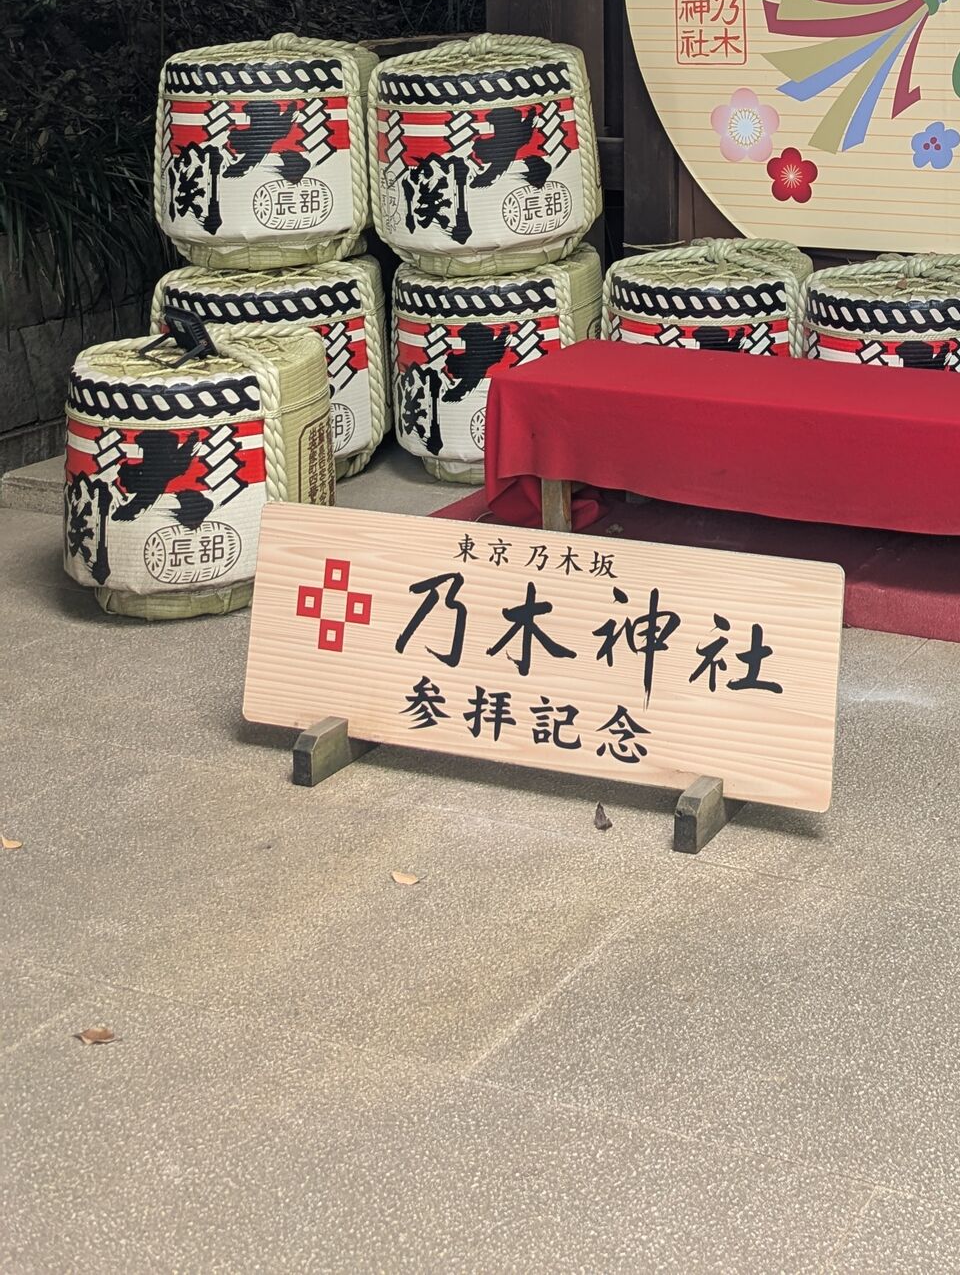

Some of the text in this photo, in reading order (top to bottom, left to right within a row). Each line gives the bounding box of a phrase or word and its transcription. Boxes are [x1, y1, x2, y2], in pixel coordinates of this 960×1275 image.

[274, 190, 321, 215] 長部
[522, 192, 563, 221] 長部
[168, 535, 225, 568] 長部
[453, 532, 619, 580] 東京 乃木坂
[394, 572, 784, 711] 乃木神社
[398, 676, 653, 765] 参拝記念
